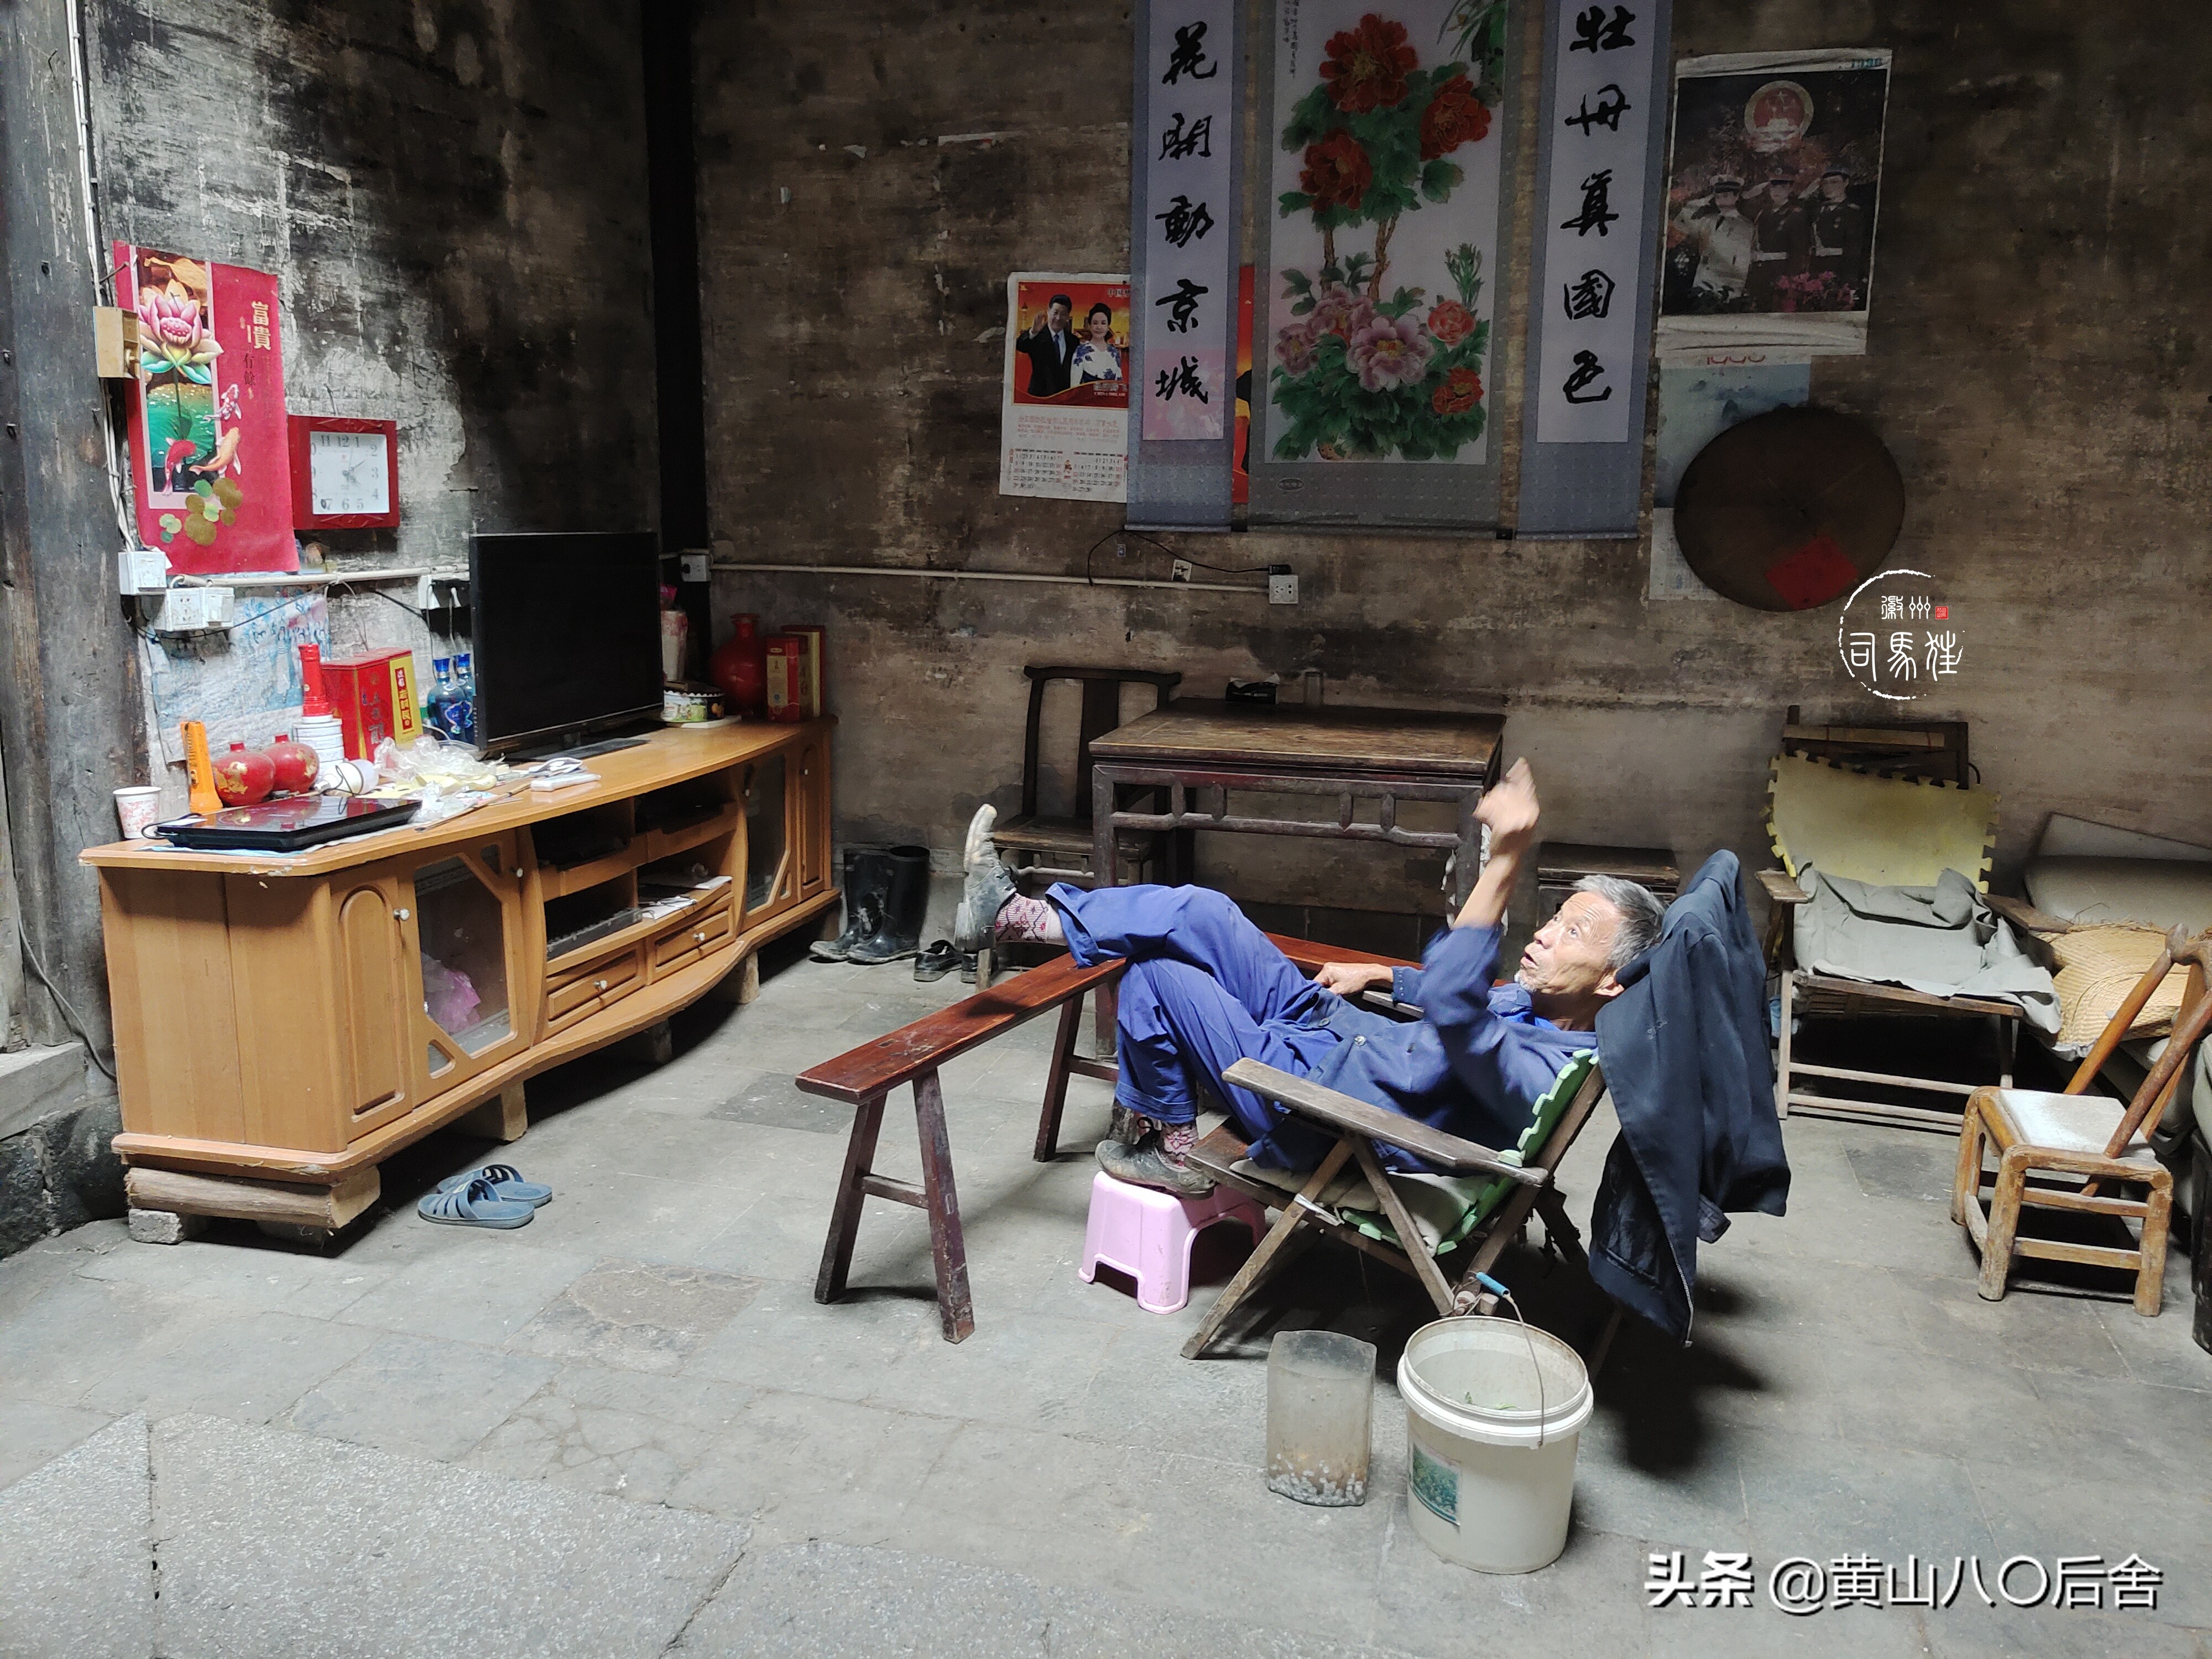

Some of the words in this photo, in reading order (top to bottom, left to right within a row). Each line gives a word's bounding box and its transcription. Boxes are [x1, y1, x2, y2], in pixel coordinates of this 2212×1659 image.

[252, 300, 271, 350] 富貴
[321, 435, 331, 447] 11
[338, 435, 349, 447] 12
[355, 436, 359, 448] 1
[371, 444, 378, 457] 2
[371, 467, 379, 479] 3
[372, 488, 379, 500] 4
[342, 498, 349, 510] 6
[356, 498, 363, 510] 5
